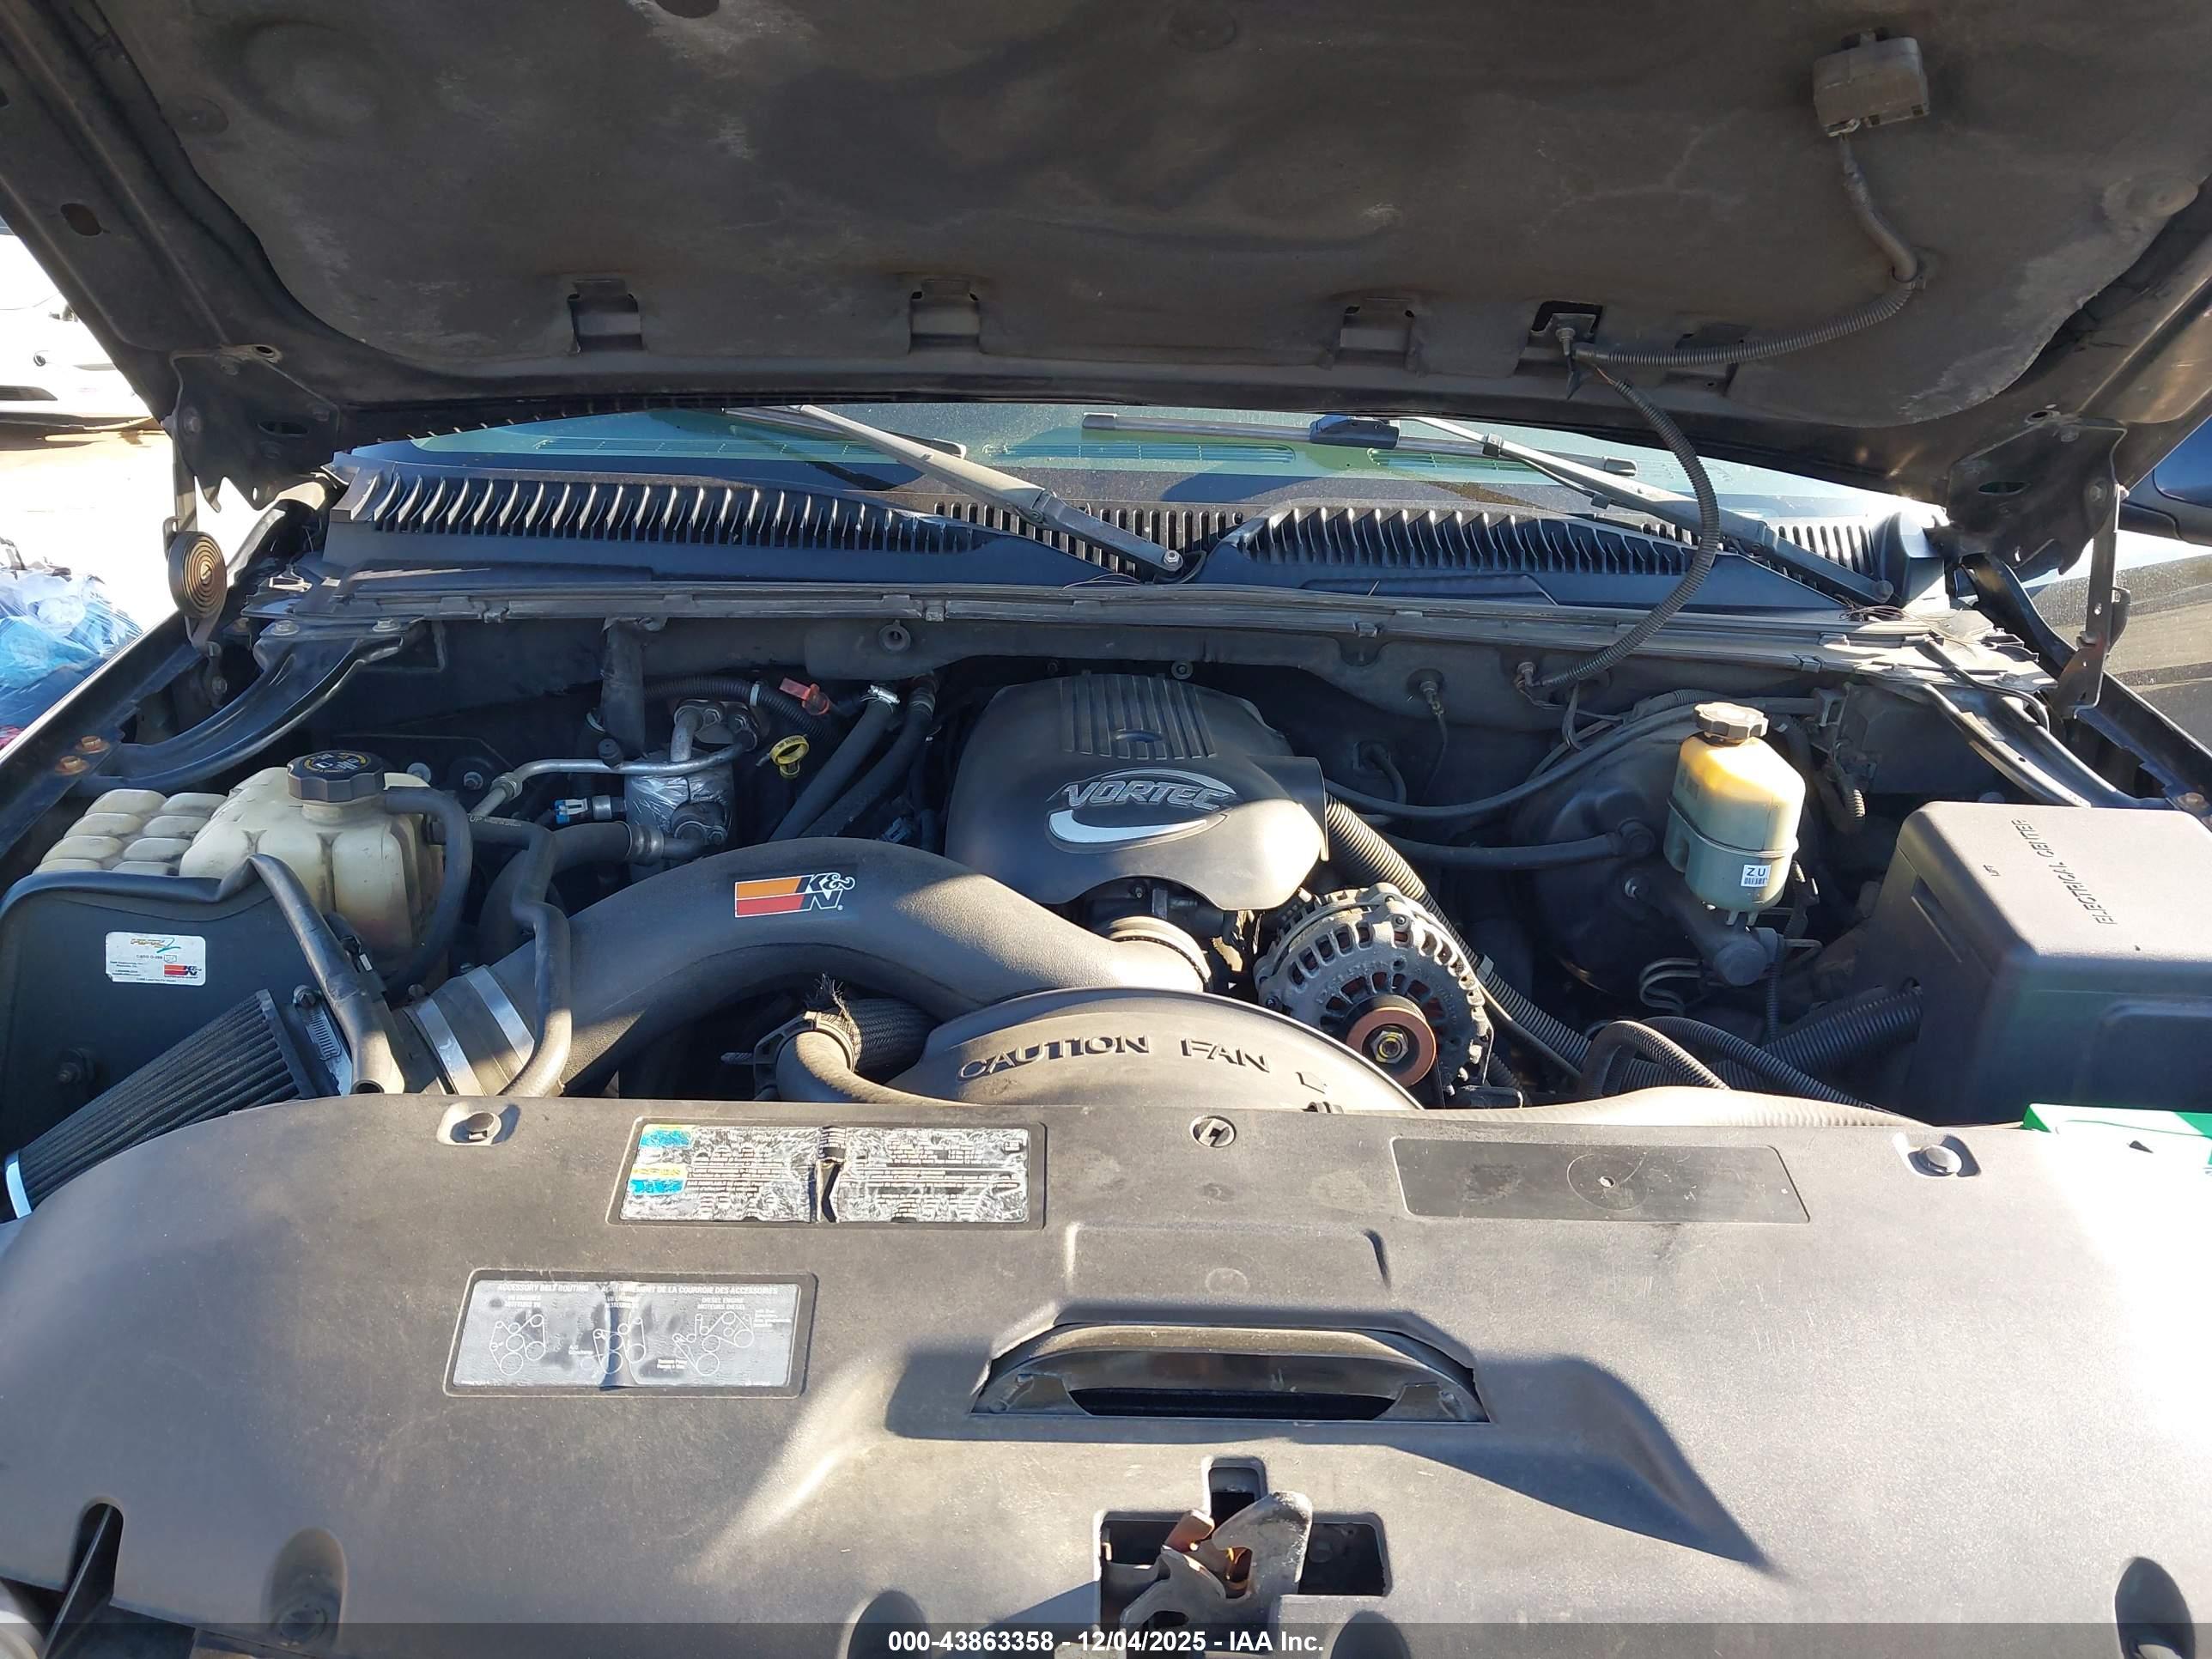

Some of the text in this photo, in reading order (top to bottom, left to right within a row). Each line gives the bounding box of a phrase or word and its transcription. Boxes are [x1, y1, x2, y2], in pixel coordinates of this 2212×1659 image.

[1062, 781, 1231, 812] VORTEC
[2048, 861, 2118, 925] ELECTRICAL
[957, 1035, 1271, 1082] CAUTION FAN
